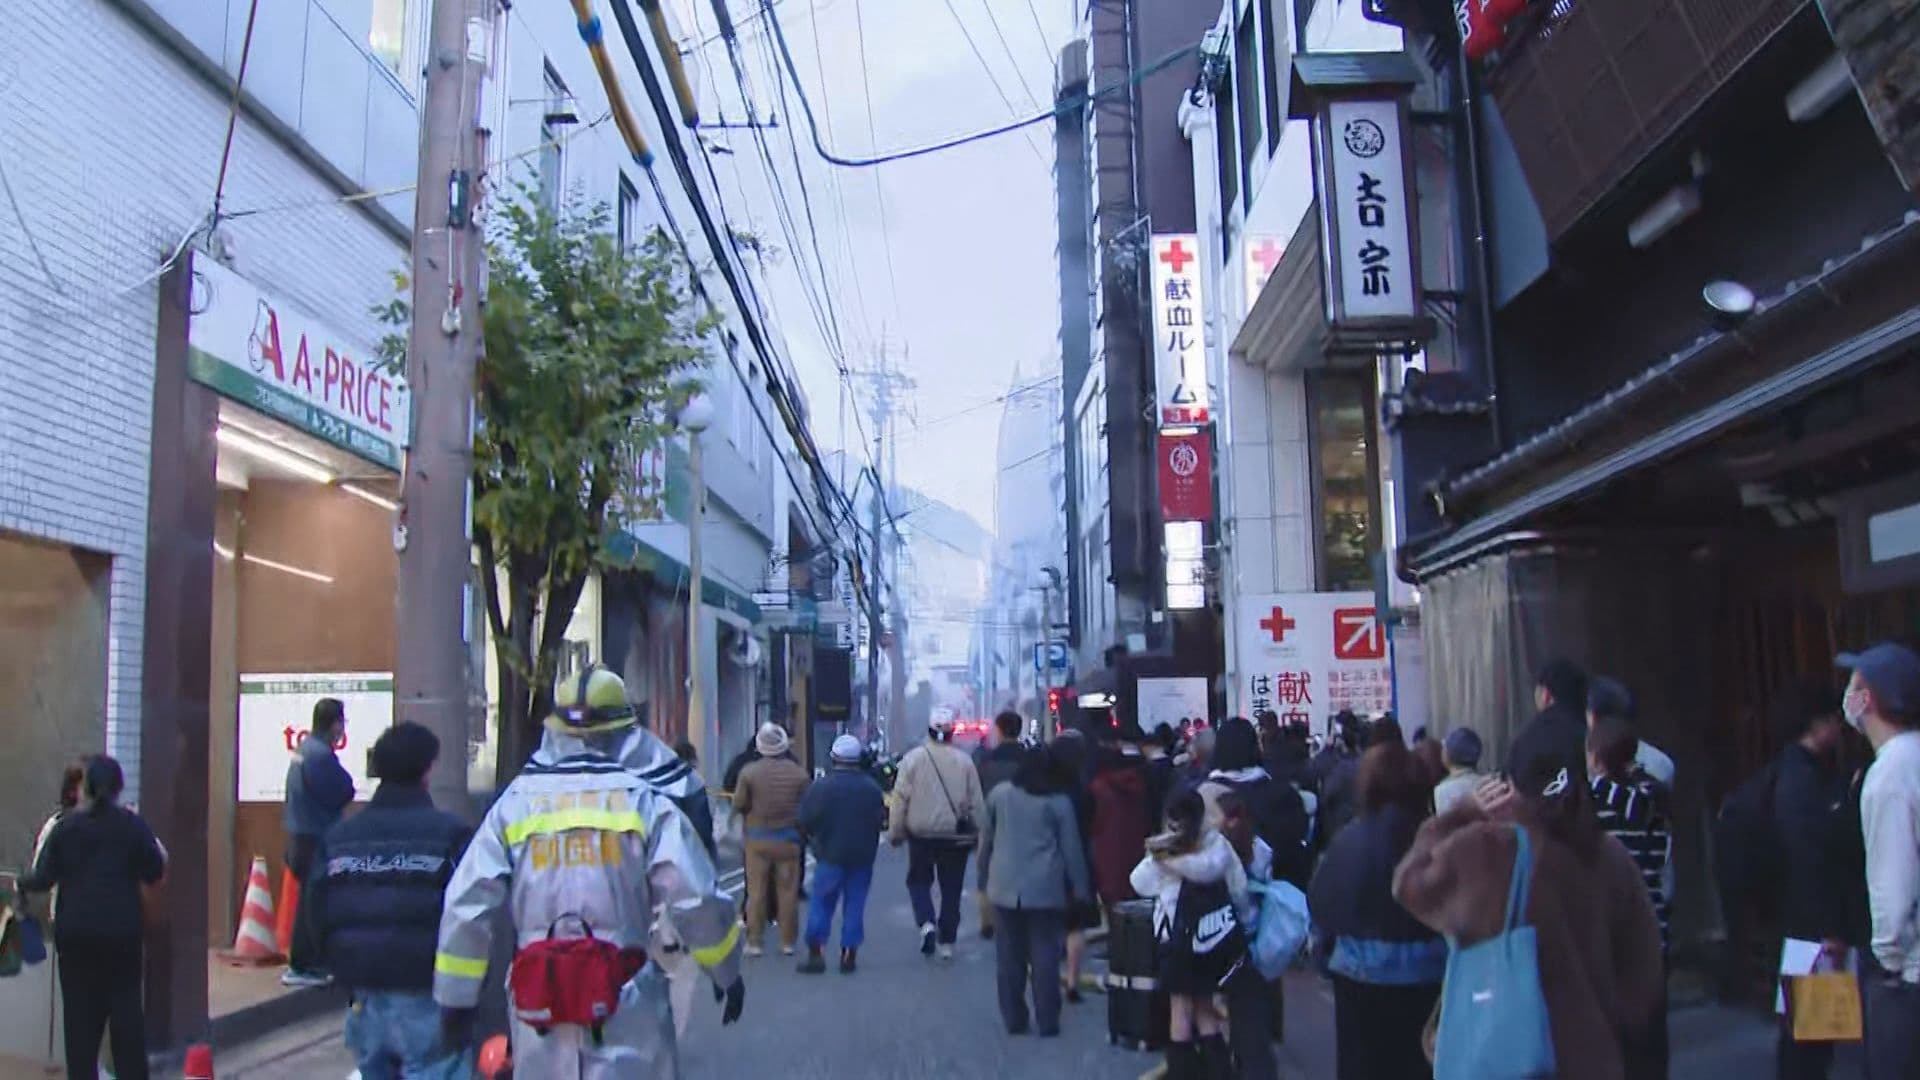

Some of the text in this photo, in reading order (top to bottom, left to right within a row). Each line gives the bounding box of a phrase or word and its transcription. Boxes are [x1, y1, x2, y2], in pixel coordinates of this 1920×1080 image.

[1356, 172, 1390, 296] 吉宗
[292, 333, 393, 433] A-PRICE
[1164, 278, 1197, 404] 献血ルーム
